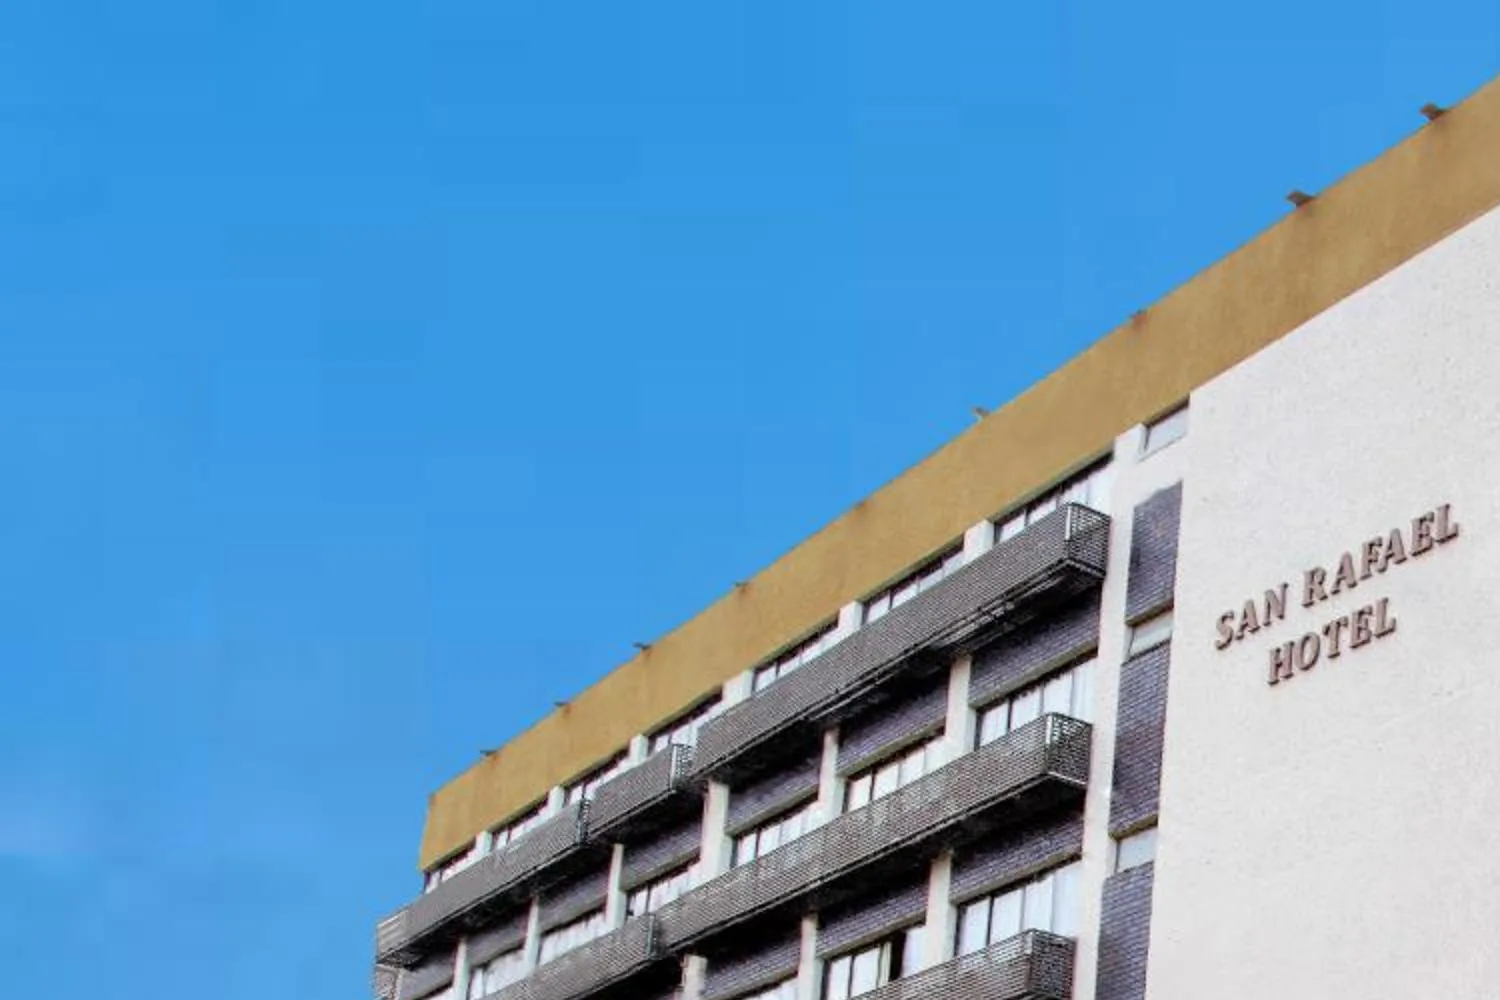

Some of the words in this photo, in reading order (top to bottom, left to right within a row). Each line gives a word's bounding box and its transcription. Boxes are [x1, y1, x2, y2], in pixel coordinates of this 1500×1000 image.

[1213, 582, 1289, 650] SAN
[1301, 503, 1460, 608] RAFAEL
[1267, 597, 1397, 686] HOTEL
